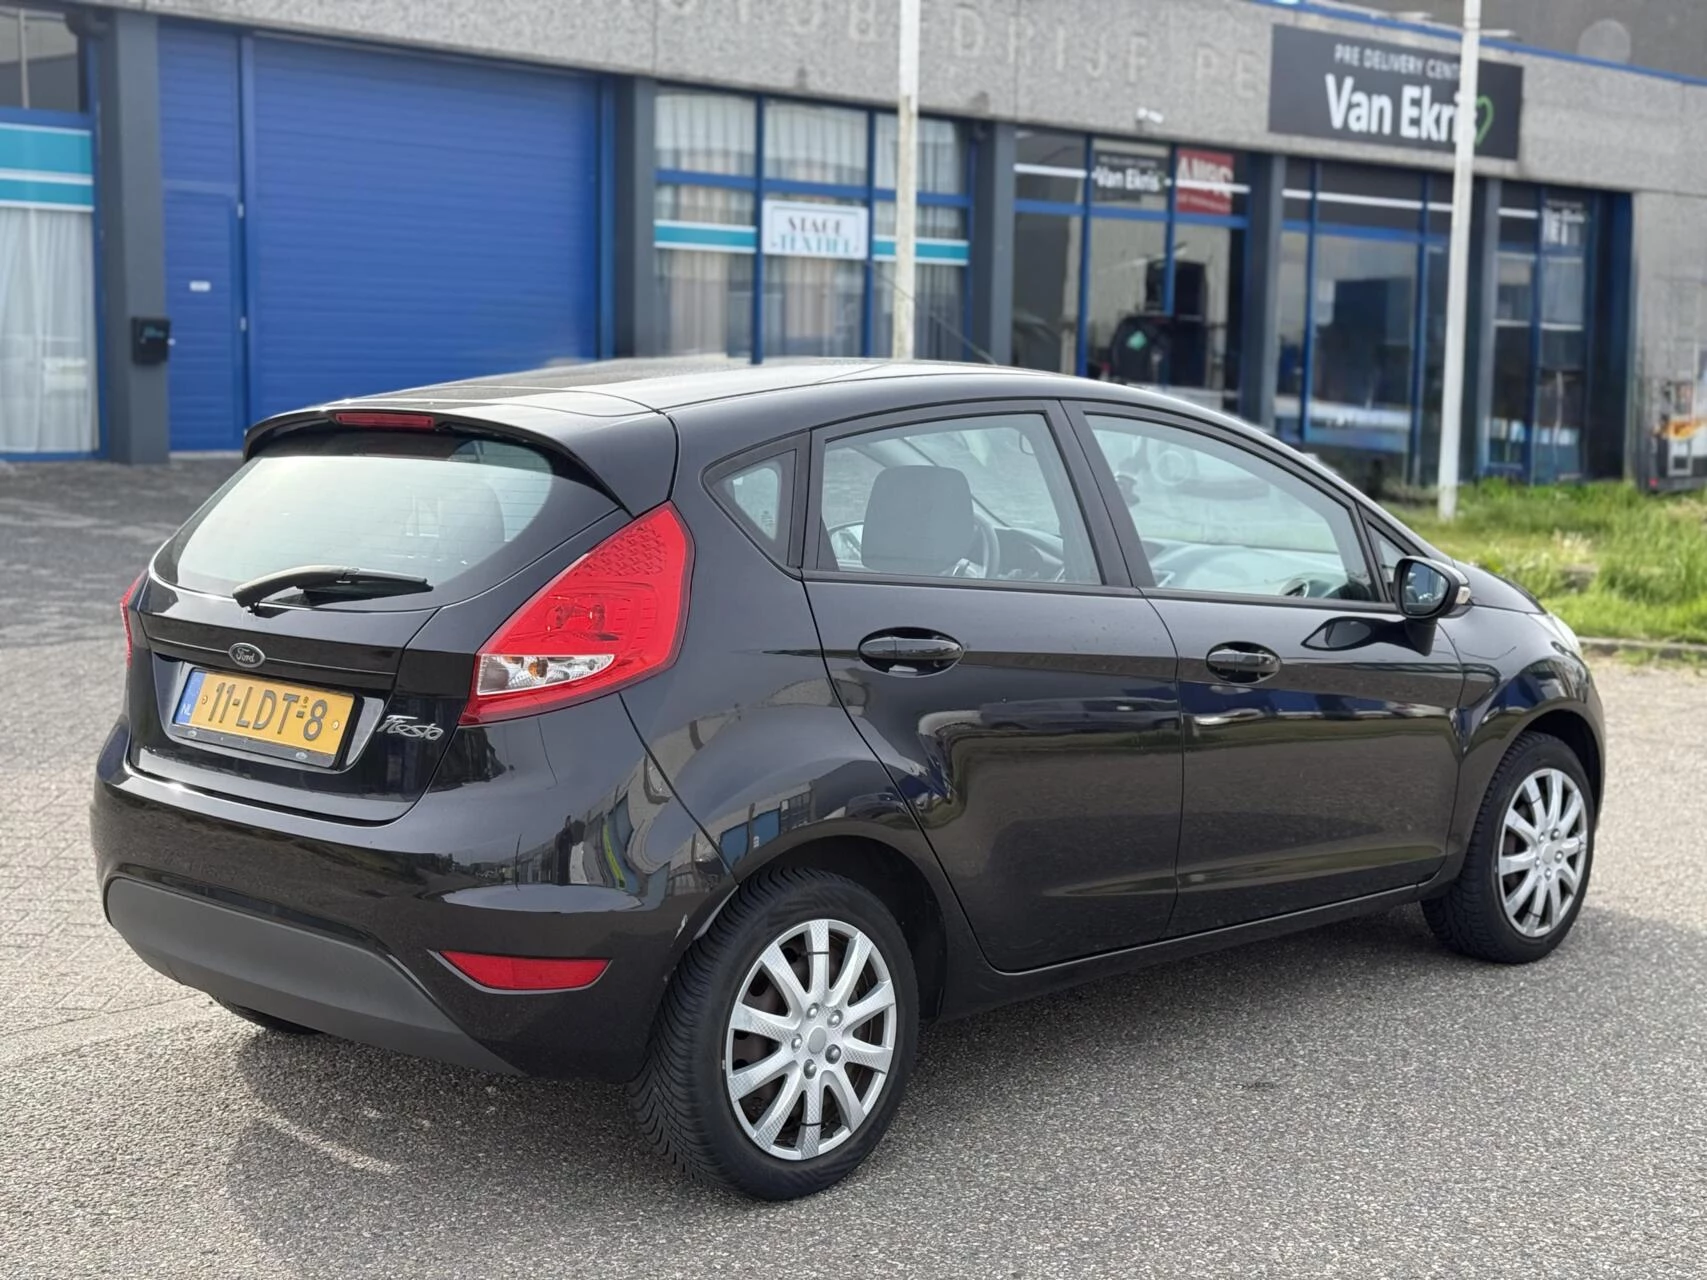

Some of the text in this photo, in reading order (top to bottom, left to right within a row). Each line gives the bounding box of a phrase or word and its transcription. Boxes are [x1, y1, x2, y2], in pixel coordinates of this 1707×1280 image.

[1334, 43, 1360, 67] PRE
[1363, 48, 1424, 75] DELIVERY
[1325, 72, 1393, 135] Van
[235, 647, 256, 663] Ford
[207, 681, 328, 742] 11-LDT-8
[376, 714, 444, 741] Fiesta
